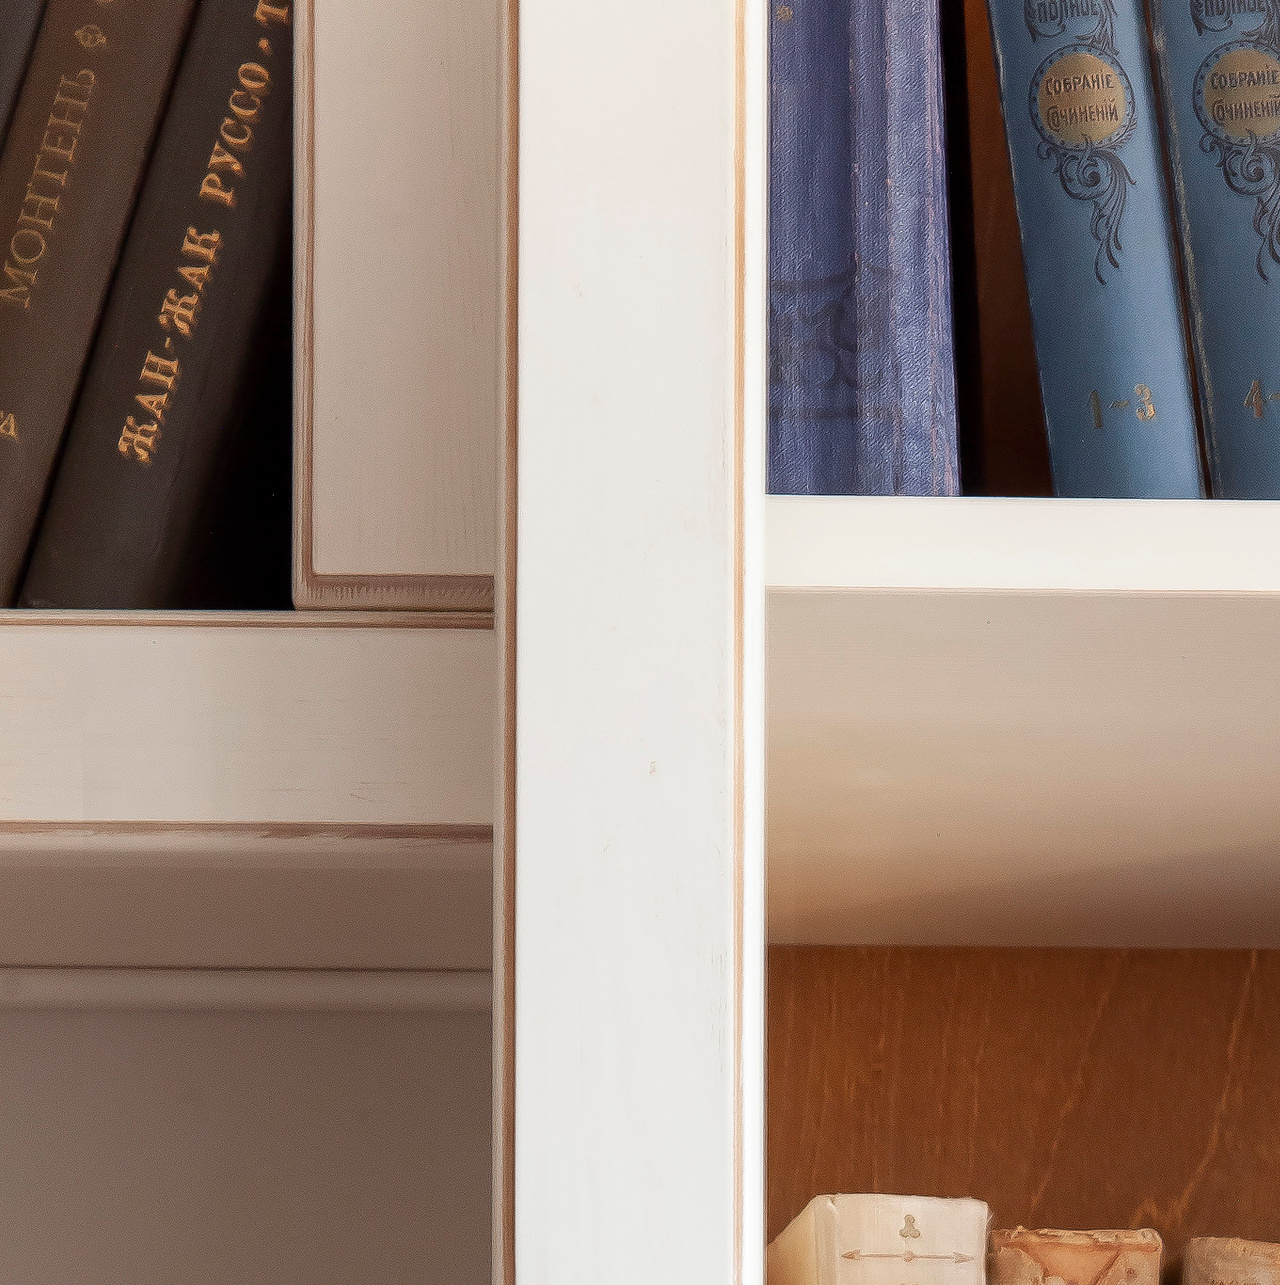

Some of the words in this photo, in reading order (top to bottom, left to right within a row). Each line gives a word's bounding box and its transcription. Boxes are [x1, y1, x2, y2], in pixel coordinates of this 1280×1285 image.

[0, 68, 95, 308] МОНТЕНЬ
[118, 226, 220, 463] ЖАН-ЖАК
[200, 61, 271, 207] РУССО
